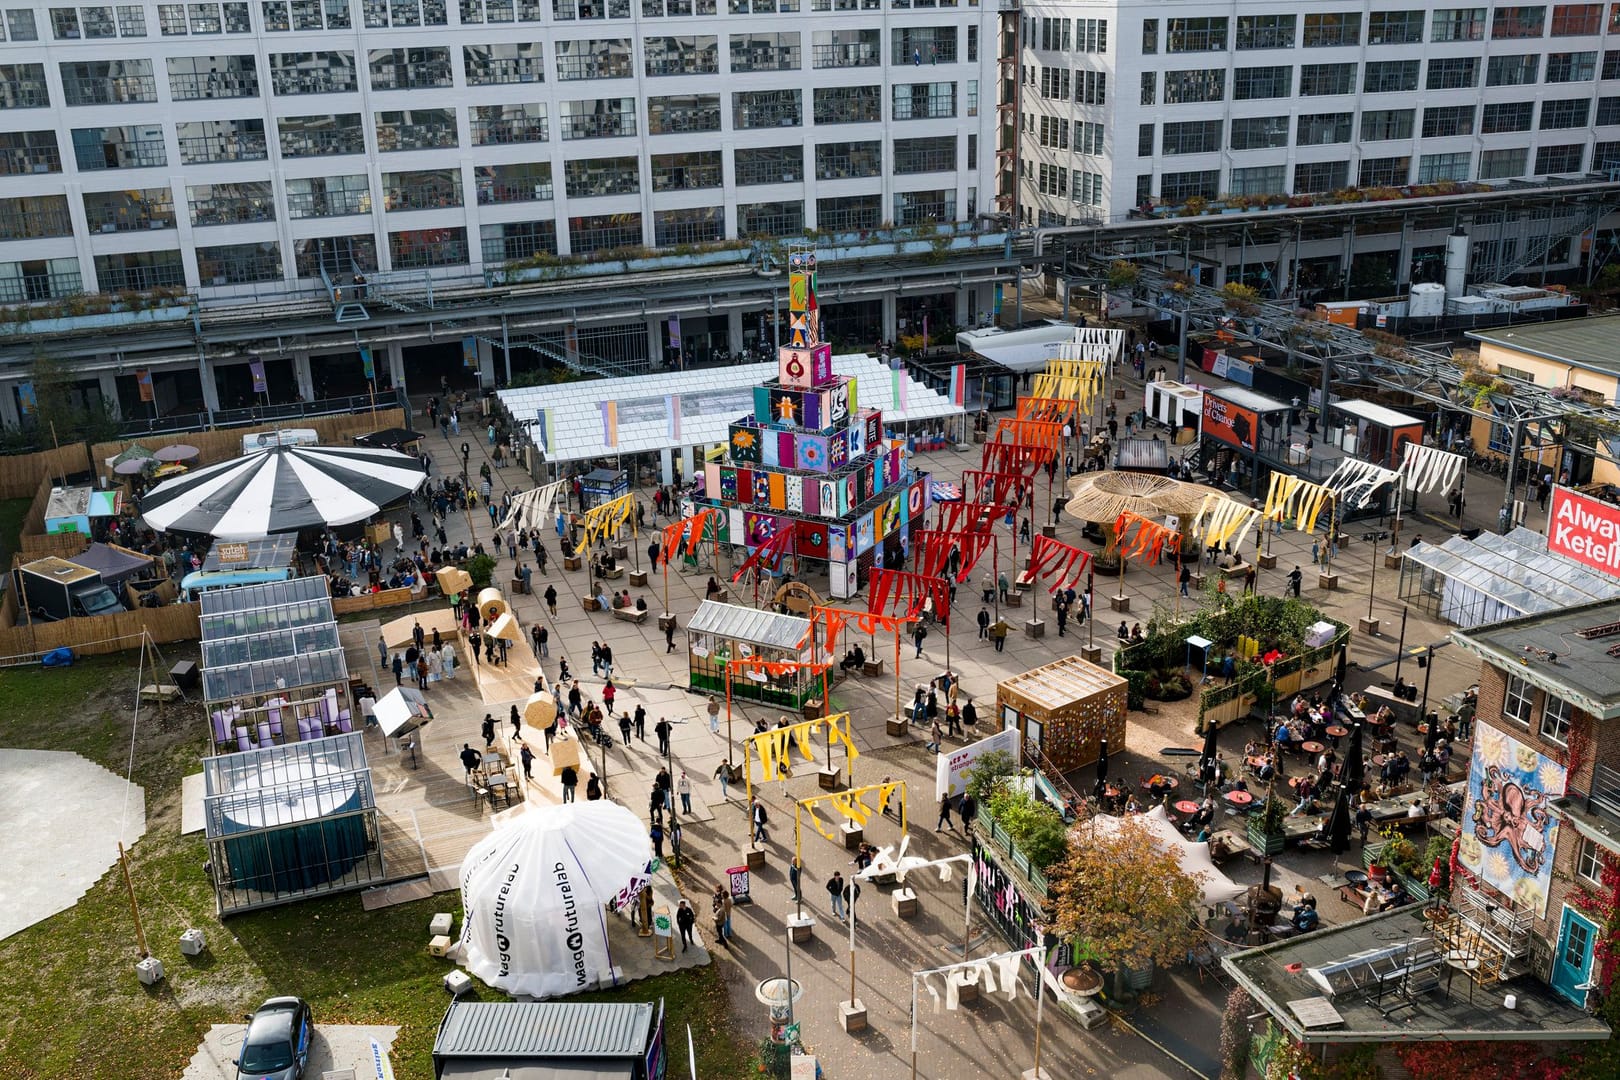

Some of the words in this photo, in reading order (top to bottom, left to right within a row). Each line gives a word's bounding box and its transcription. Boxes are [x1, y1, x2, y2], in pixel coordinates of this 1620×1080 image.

[1204, 407, 1211, 417] of
[1211, 409, 1235, 428] Change
[1205, 395, 1227, 413] Drivers
[553, 862, 579, 933] futurelab
[573, 950, 586, 986] waag
